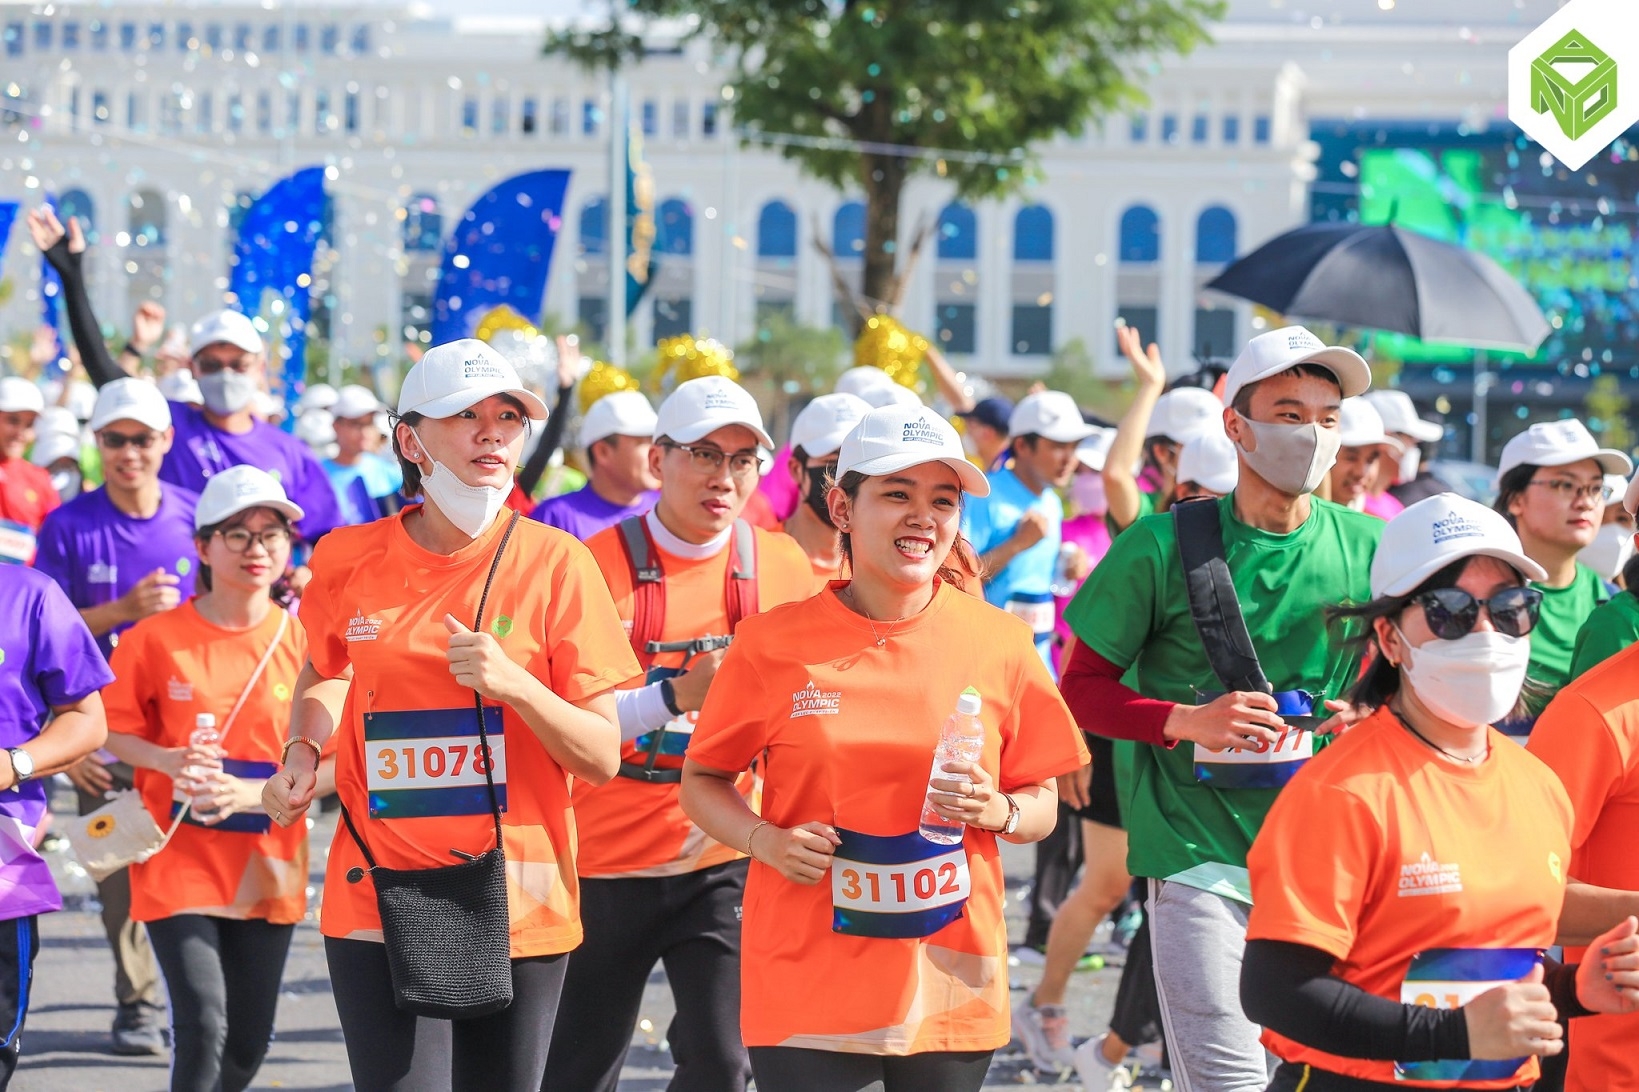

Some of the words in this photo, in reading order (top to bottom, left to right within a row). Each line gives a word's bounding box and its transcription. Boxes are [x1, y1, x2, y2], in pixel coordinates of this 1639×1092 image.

[465, 366, 502, 374] OLYMPIC
[903, 422, 931, 430] NOVA
[902, 429, 944, 441] OLYMPIC
[1432, 517, 1465, 529] NOVA
[792, 689, 821, 702] NOVA
[792, 698, 840, 712] OLYMPIC
[377, 744, 495, 780] 31078
[1400, 861, 1439, 876] NOVA
[841, 861, 960, 903] 31102
[1398, 871, 1460, 888] OLYMPIC
